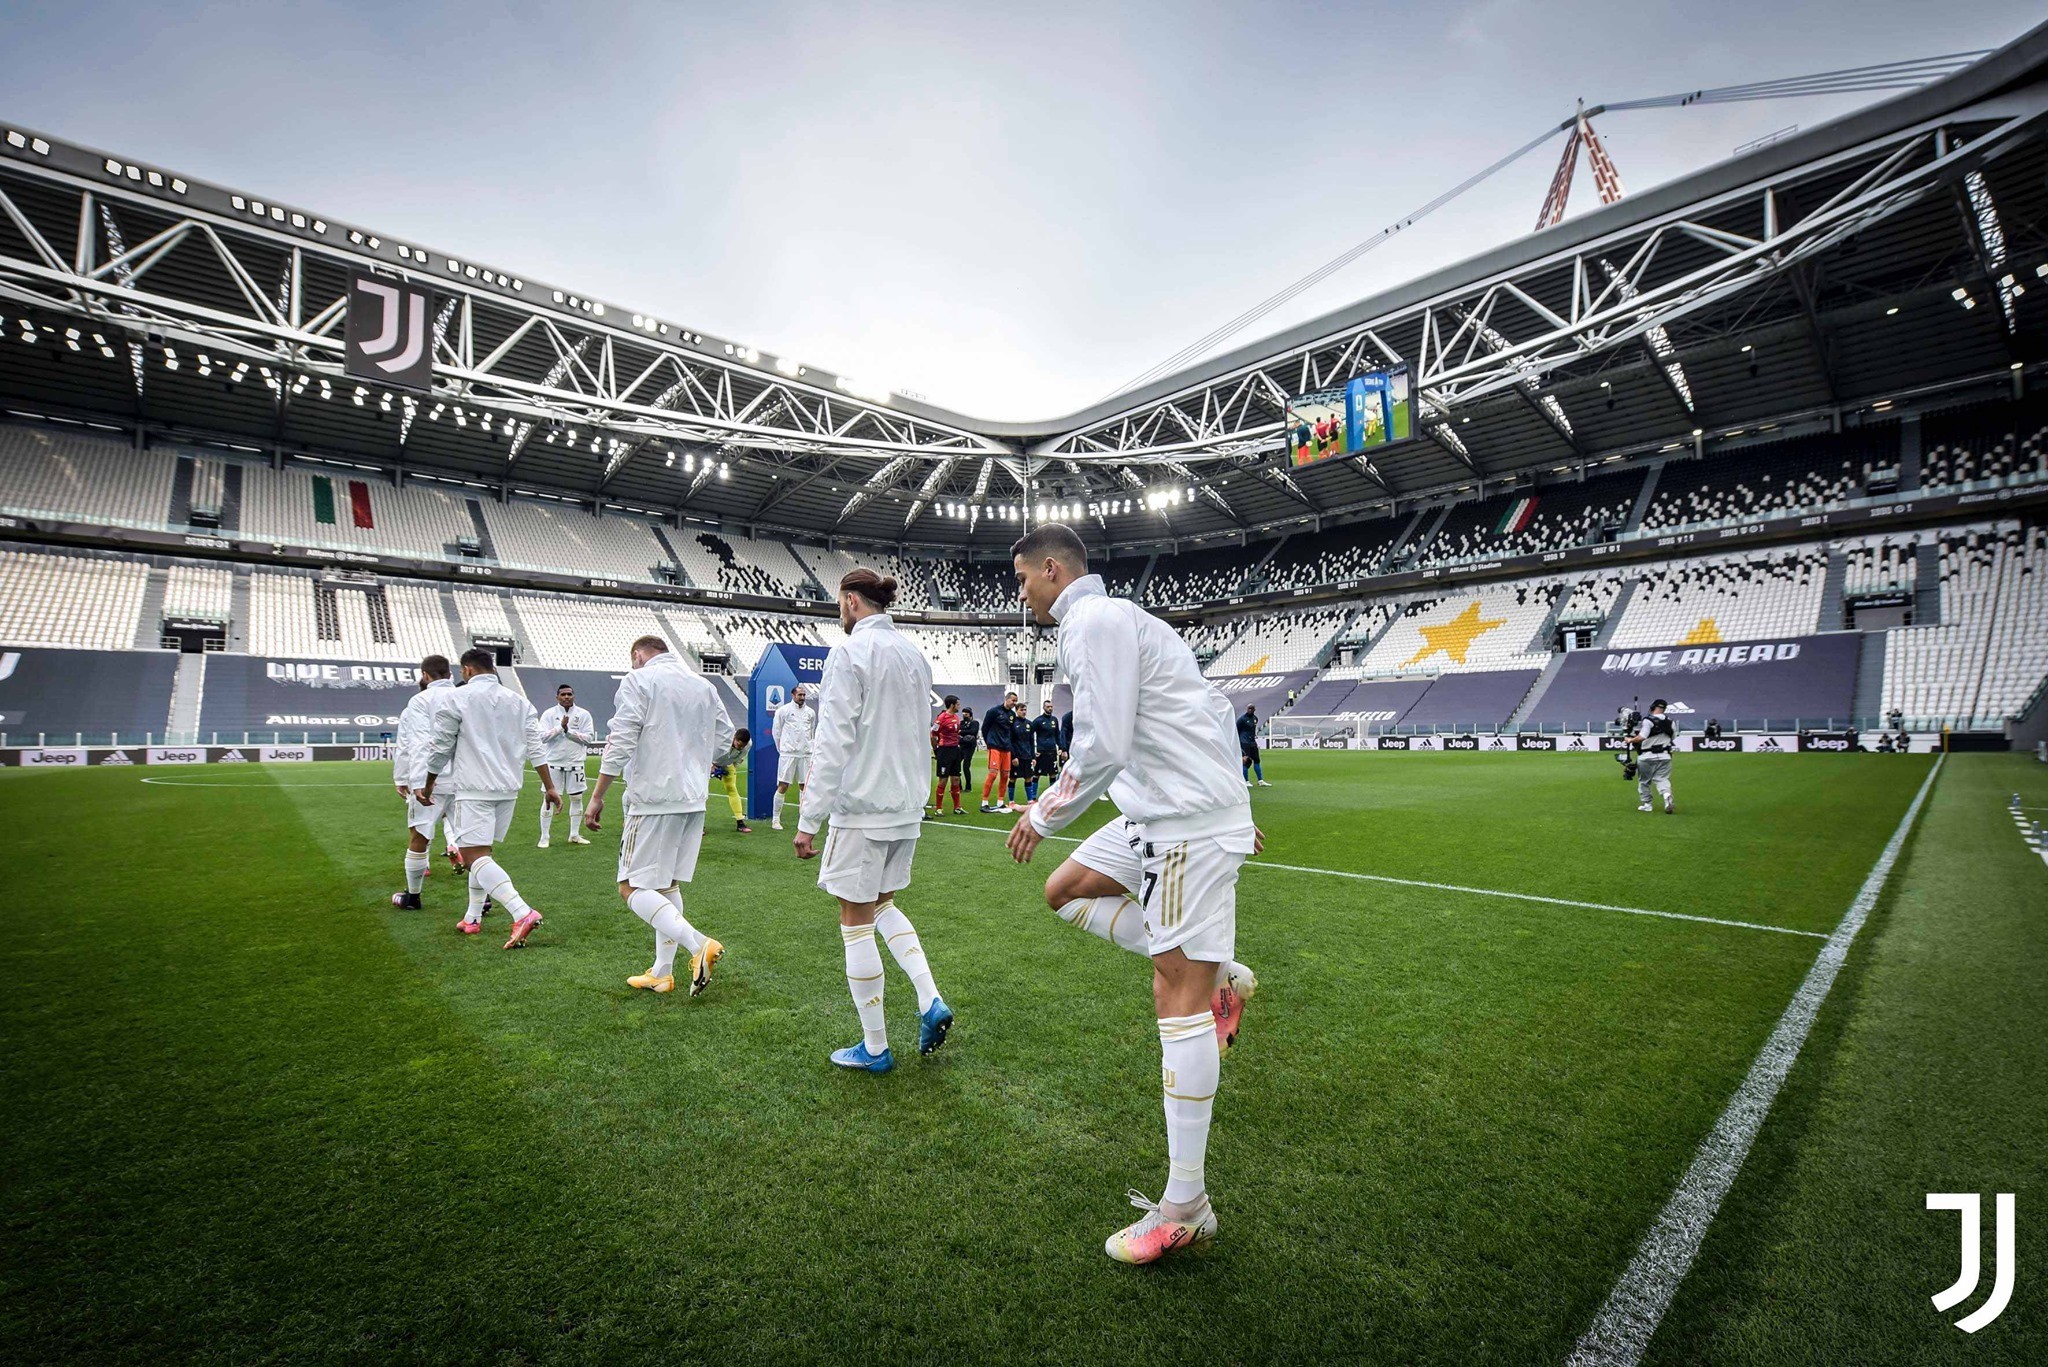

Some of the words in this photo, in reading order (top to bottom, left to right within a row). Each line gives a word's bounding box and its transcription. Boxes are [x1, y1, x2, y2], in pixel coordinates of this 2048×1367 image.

[1958, 493, 1997, 504] Allianz
[306, 549, 335, 559] Allianz
[346, 553, 379, 563] Stadium
[1478, 562, 1502, 570] Stadium
[1601, 650, 1673, 671] LIVE
[1679, 643, 1800, 665] AHEAD
[798, 657, 824, 670] SER
[267, 662, 340, 682] LIVE
[350, 666, 423, 682] AHE
[1221, 676, 1286, 690] AHEAD
[266, 715, 350, 725] Allianz
[1323, 739, 1344, 749] Jeep
[1382, 739, 1406, 750] Jeep
[1448, 739, 1474, 750] Jeep
[1522, 739, 1550, 750] Jeep
[1699, 738, 1736, 750] Jeep
[1807, 737, 1849, 750] Jeep
[157, 751, 197, 762] Jeep
[269, 750, 304, 761] Jeep
[352, 747, 394, 762] JUVEN
[586, 747, 605, 756] eep
[32, 752, 77, 765] Jeep
[575, 772, 585, 783] 12
[1143, 871, 1158, 911] 7
